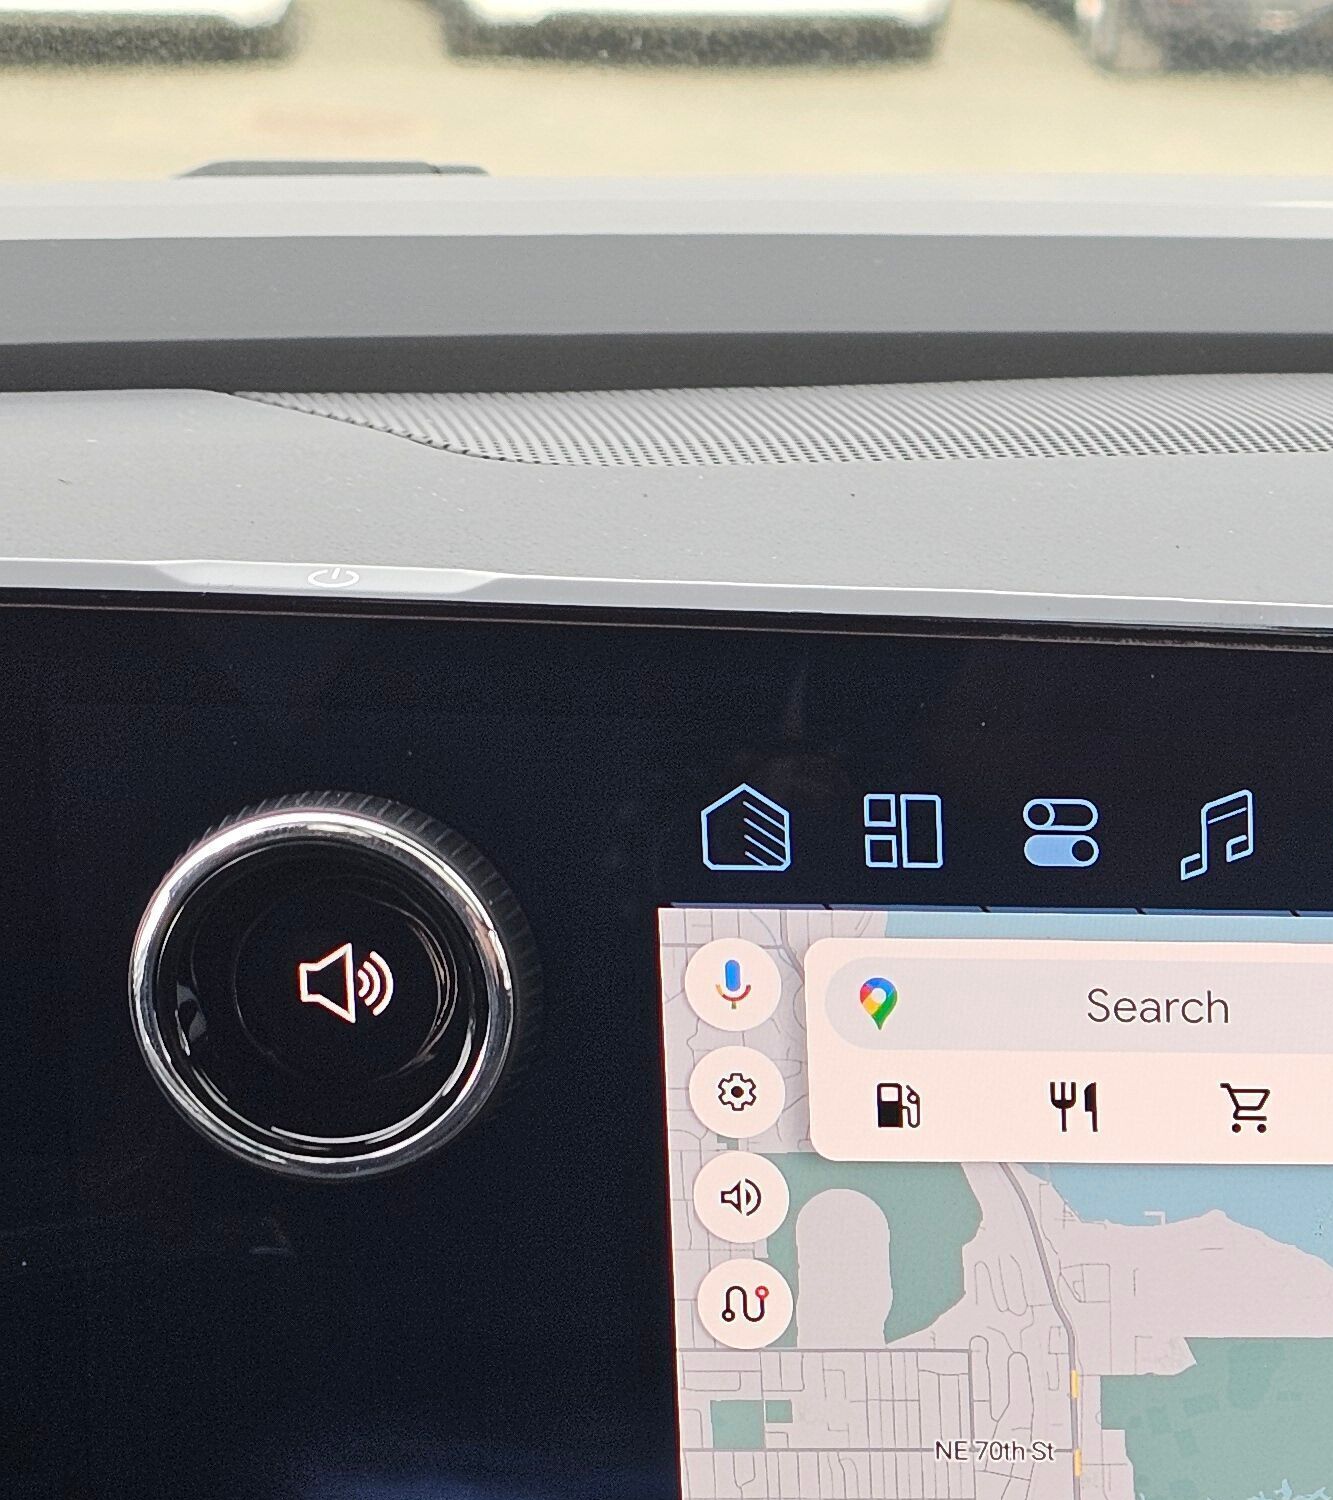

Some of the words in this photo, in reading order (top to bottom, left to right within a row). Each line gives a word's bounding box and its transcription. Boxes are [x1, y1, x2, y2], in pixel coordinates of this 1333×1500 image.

[1087, 988, 1229, 1024] Search
[935, 1441, 968, 1461] NE
[976, 1440, 1024, 1462] 70th
[1025, 1441, 1055, 1462] St
